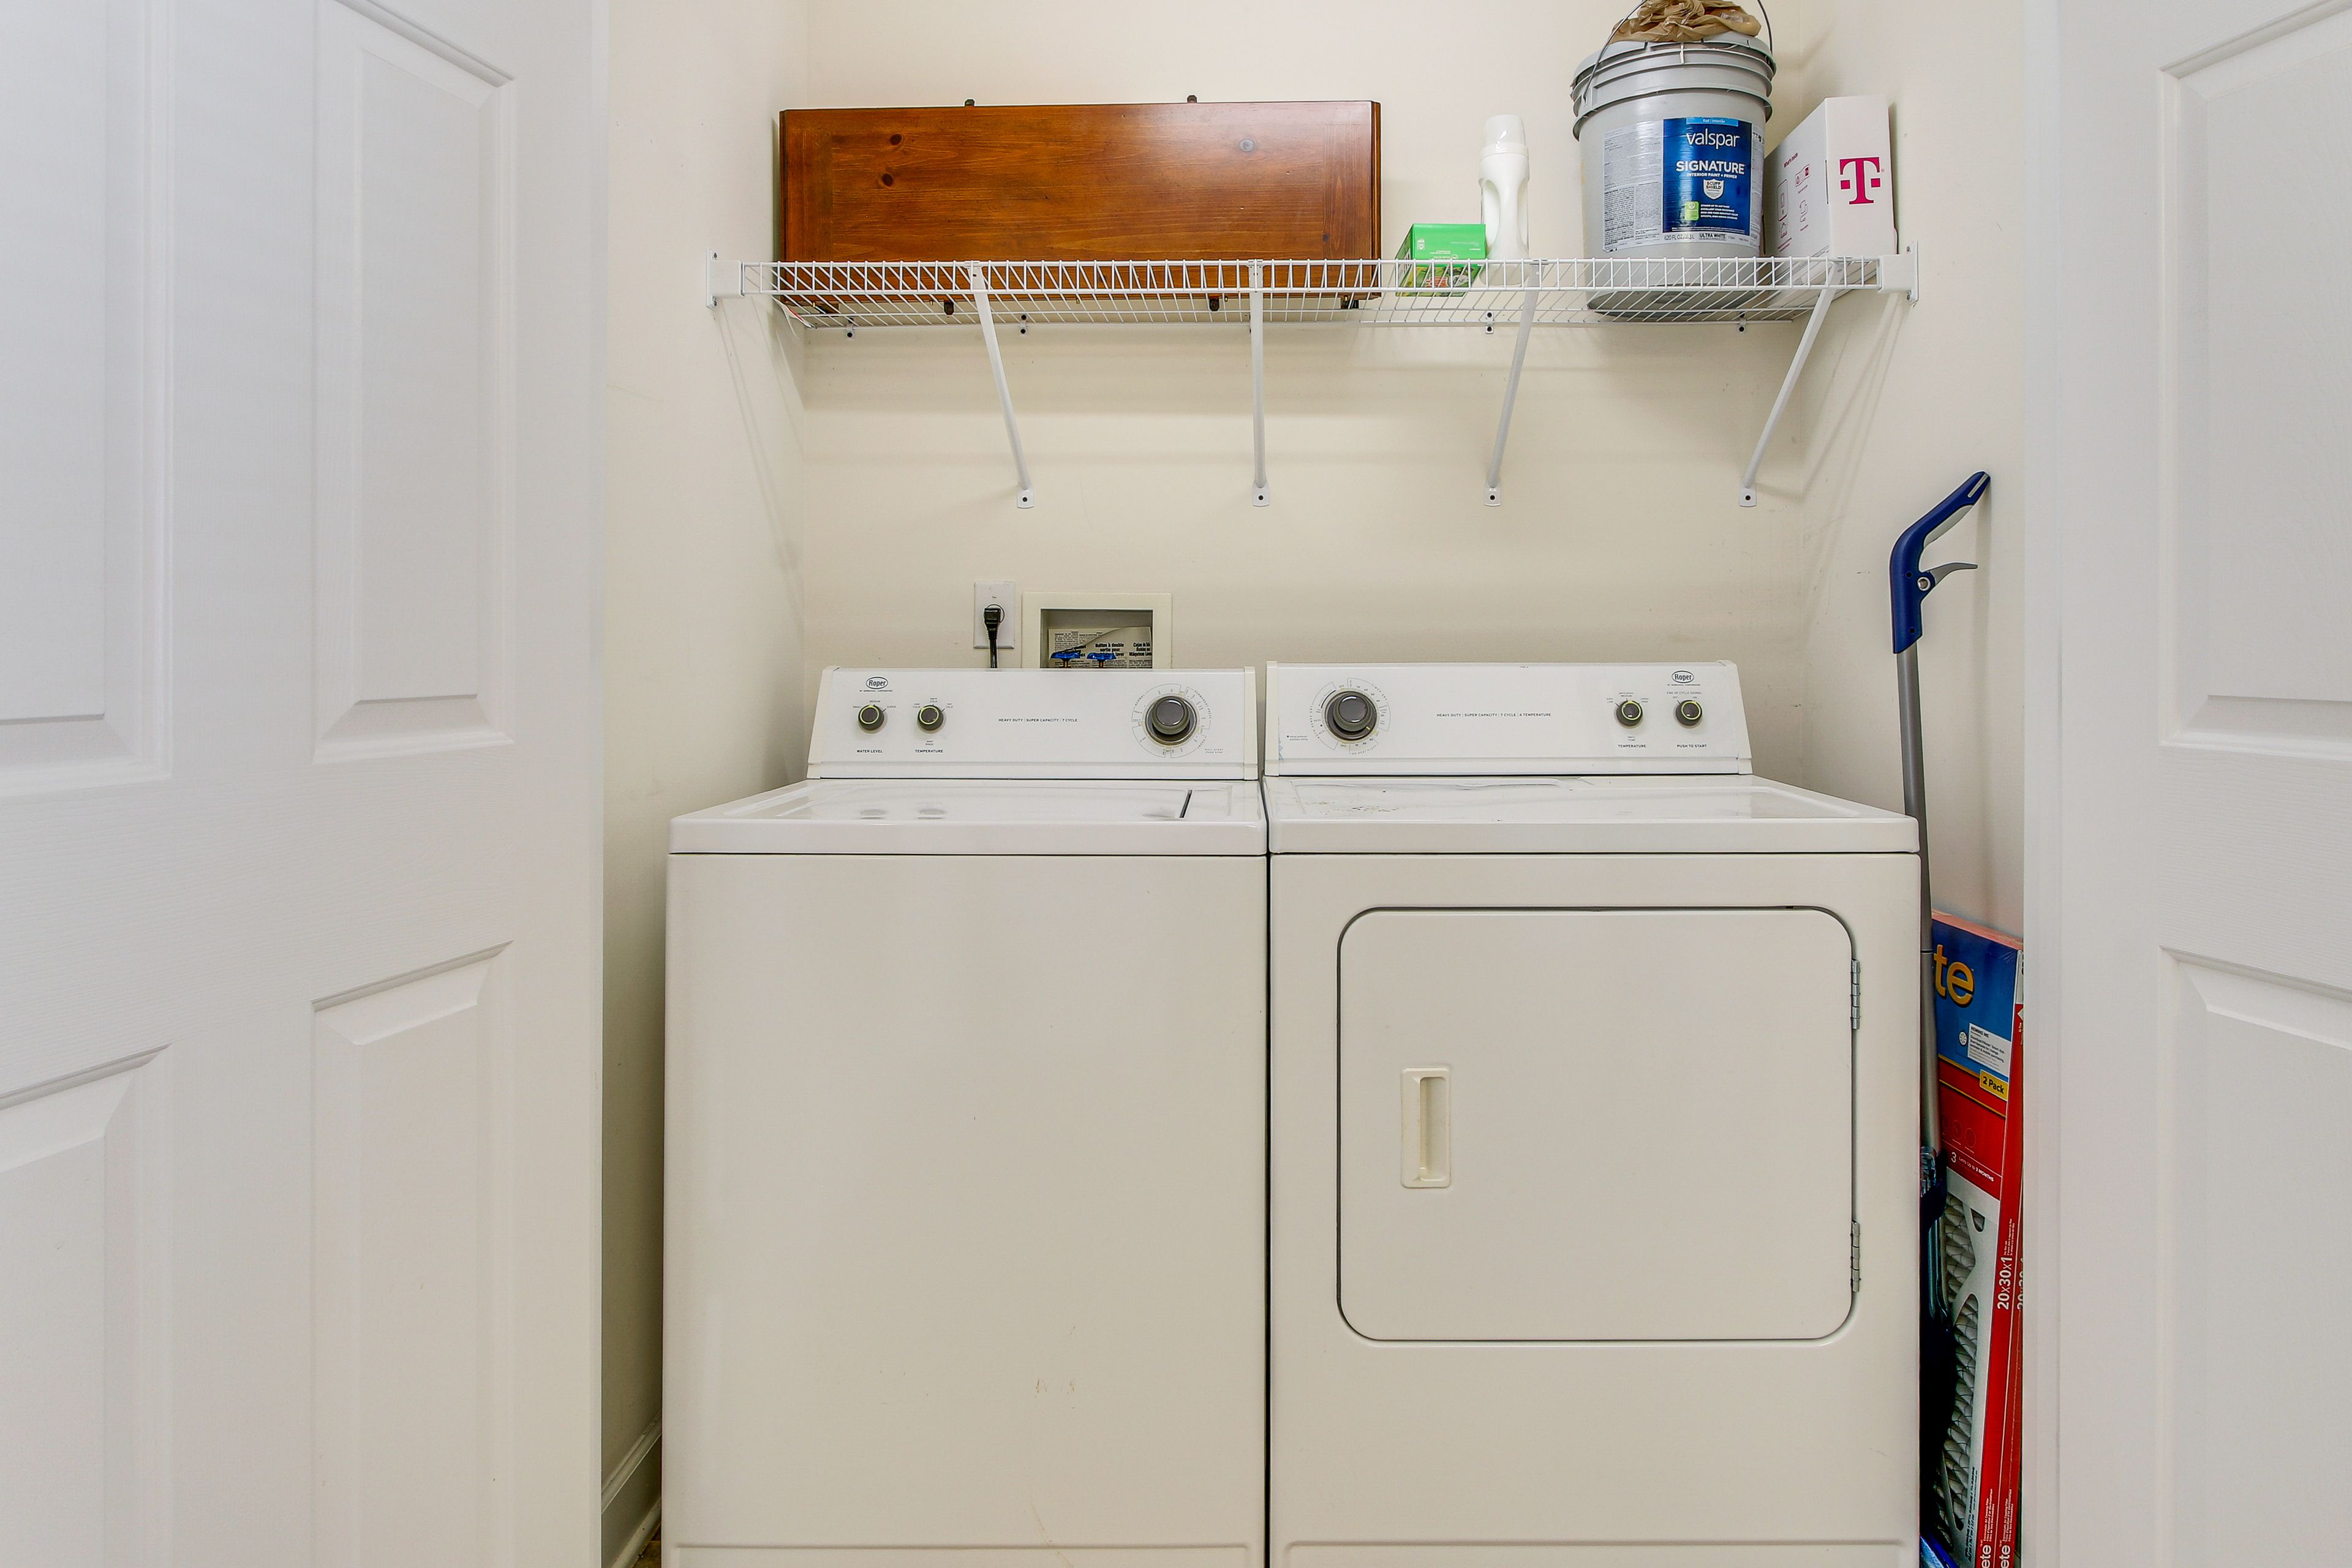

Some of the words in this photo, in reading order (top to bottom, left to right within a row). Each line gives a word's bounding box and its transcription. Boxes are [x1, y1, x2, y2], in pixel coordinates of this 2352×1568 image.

[1686, 128, 1740, 149] valspar
[1676, 160, 1745, 175] SIGNATURE
[1983, 1076, 1988, 1085] 2
[1988, 1079, 2005, 1095] Pack
[1951, 1152, 1957, 1163] 3
[1978, 1169, 1994, 1182] MONTHS
[1997, 1256, 2013, 1310] 20x30x1
